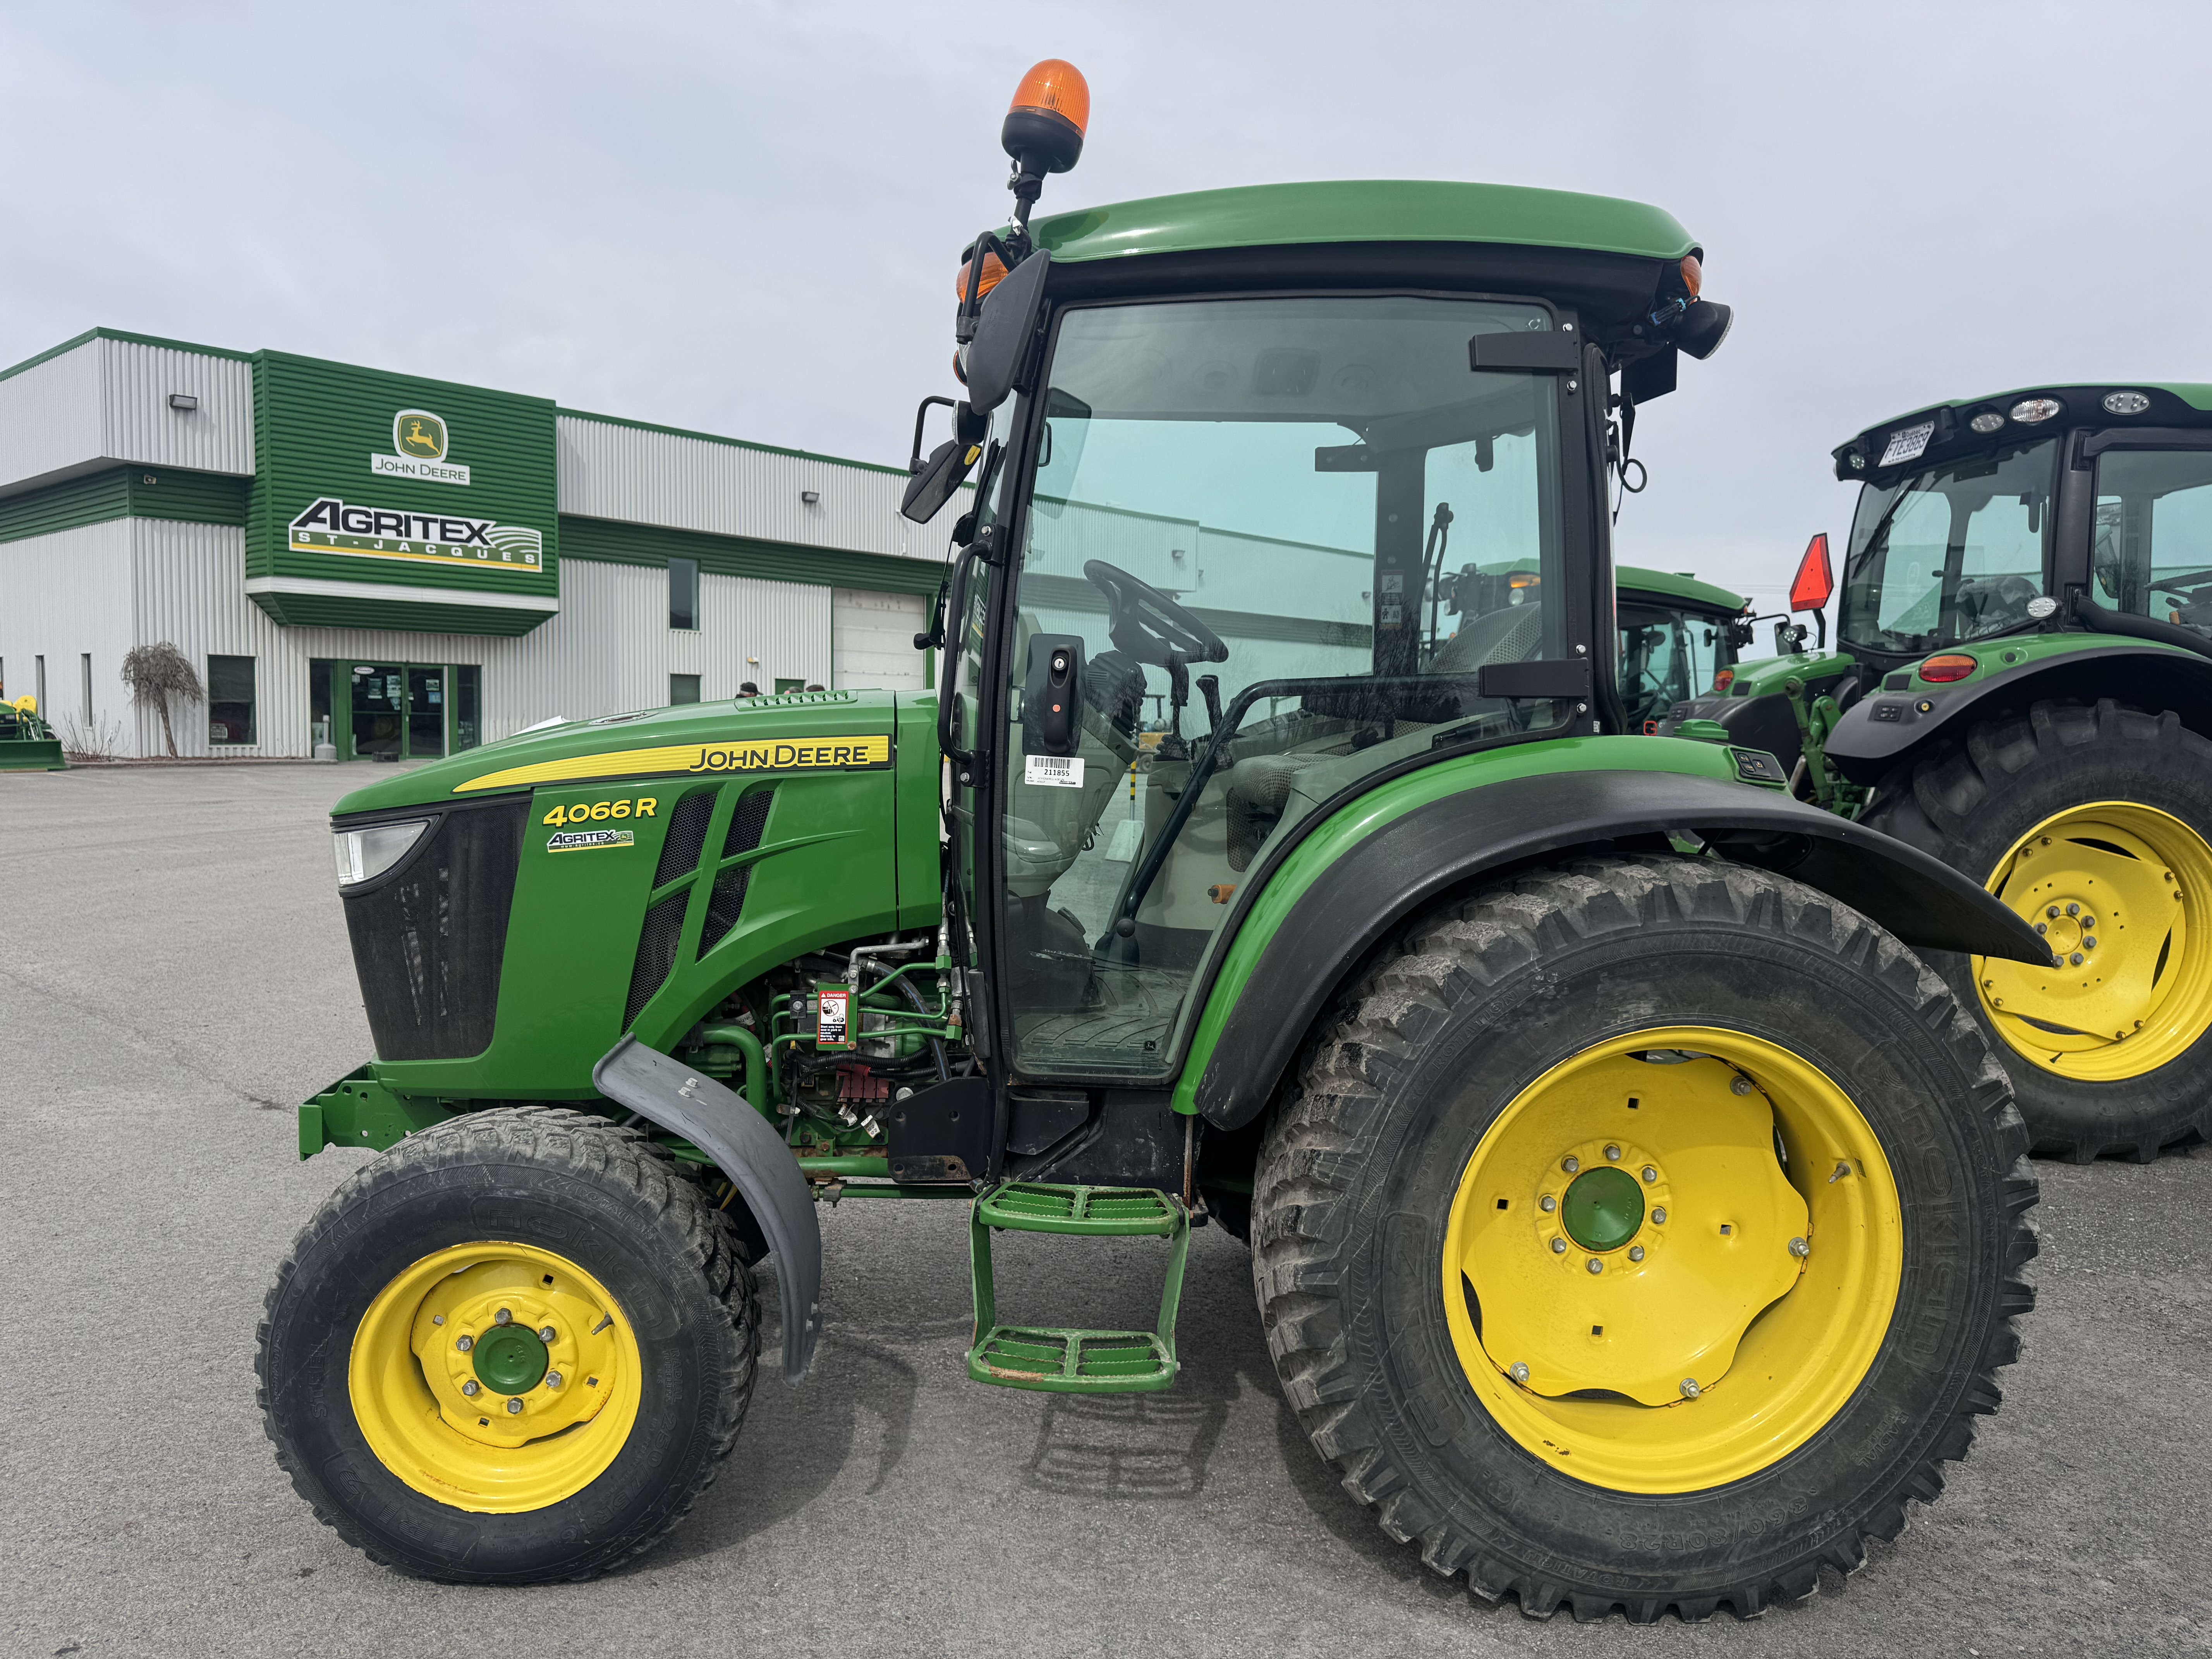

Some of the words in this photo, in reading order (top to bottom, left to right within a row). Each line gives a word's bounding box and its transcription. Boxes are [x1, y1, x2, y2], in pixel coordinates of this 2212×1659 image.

[375, 459, 415, 474] JOHN
[420, 464, 466, 481] DEERE
[292, 501, 494, 547] AGRITEX
[298, 532, 535, 565] ST-JACQUES
[690, 745, 769, 770] JOHN
[774, 744, 869, 766] DEERE
[543, 799, 632, 827] 4066
[549, 831, 615, 845] AGRITEX
[1429, 988, 1520, 1071] ROTATION
[574, 1184, 658, 1243] ROTATION
[1965, 1139, 2001, 1244] ROTATION
[270, 1317, 289, 1406] ROTATION
[307, 1336, 330, 1420] STEEL
[670, 1348, 684, 1404] RADIAL
[1382, 1306, 1461, 1432] TRI
[1854, 1410, 1911, 1474] RADIAL
[333, 1462, 374, 1500] 2
[376, 1497, 463, 1553] TRI
